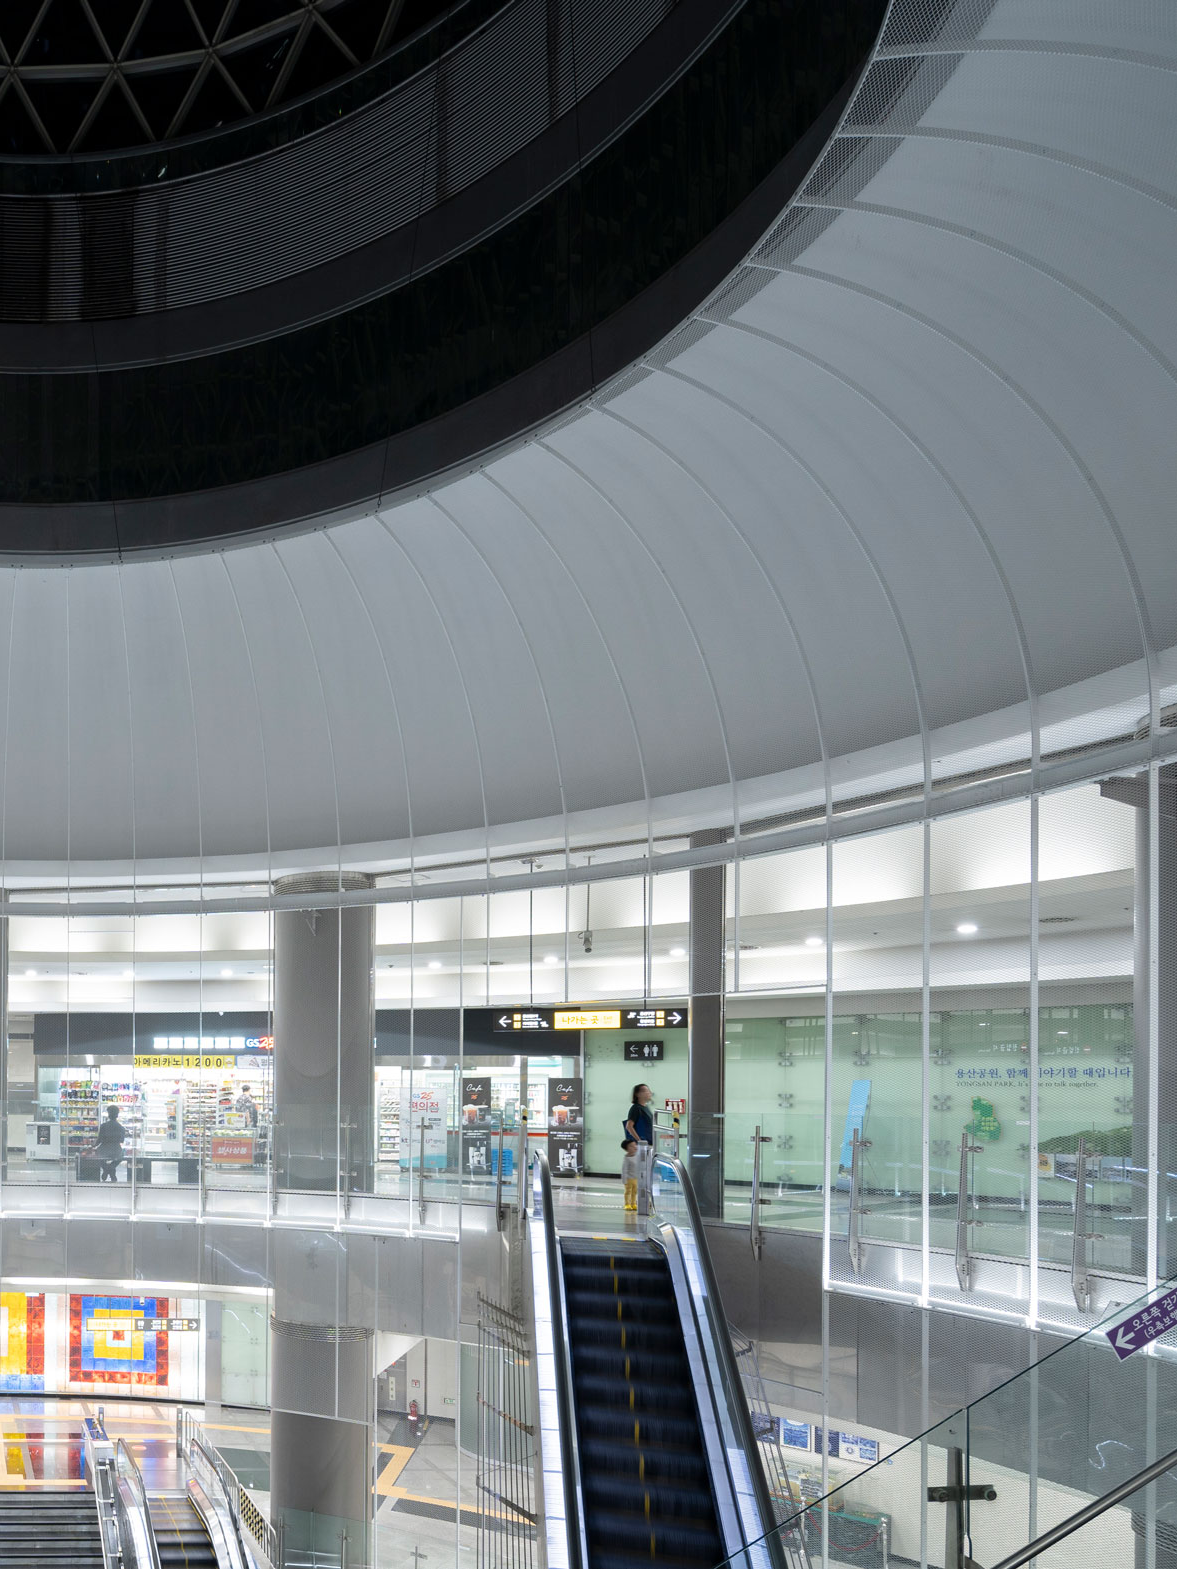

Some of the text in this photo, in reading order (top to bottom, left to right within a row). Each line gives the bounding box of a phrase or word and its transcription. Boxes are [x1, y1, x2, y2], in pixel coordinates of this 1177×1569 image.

[561, 1015, 588, 1025] 나가는
[590, 1015, 599, 1025] 곳
[134, 1057, 222, 1067] 아메리카노 1200
[1006, 1067, 1029, 1079] 함께
[1083, 1066, 1132, 1079] 때입니다
[1132, 1306, 1162, 1331] 오른쪽
